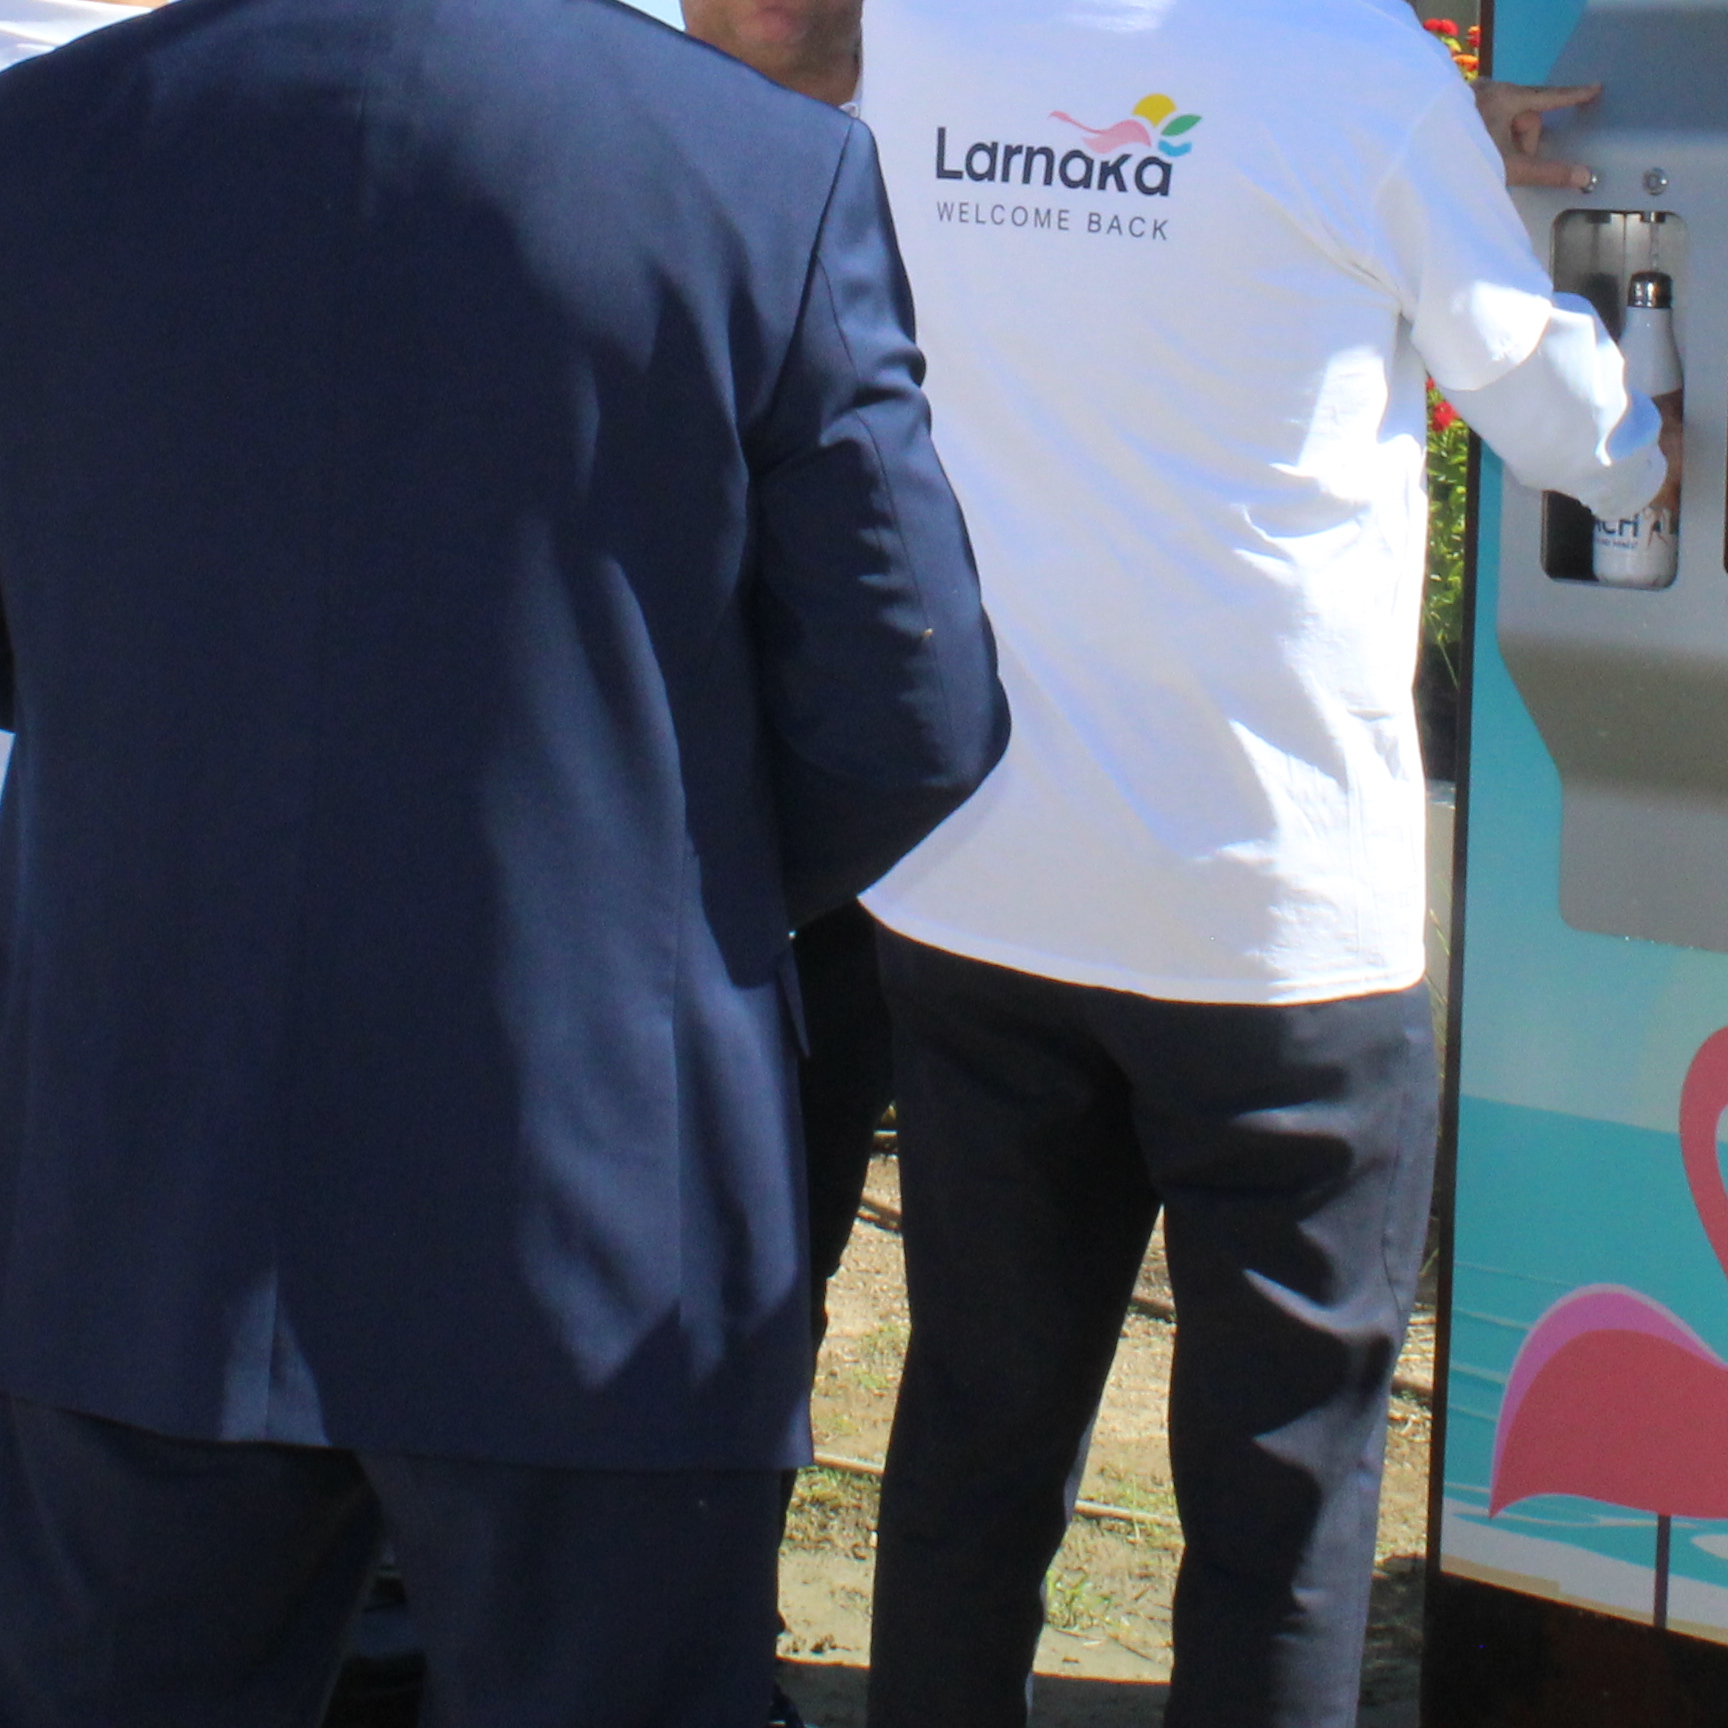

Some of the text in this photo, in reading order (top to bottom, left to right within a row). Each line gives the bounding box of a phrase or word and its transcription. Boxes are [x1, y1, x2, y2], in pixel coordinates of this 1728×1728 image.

[935, 127, 1173, 197] Larnaka
[936, 201, 1169, 242] WELCOME BACK
